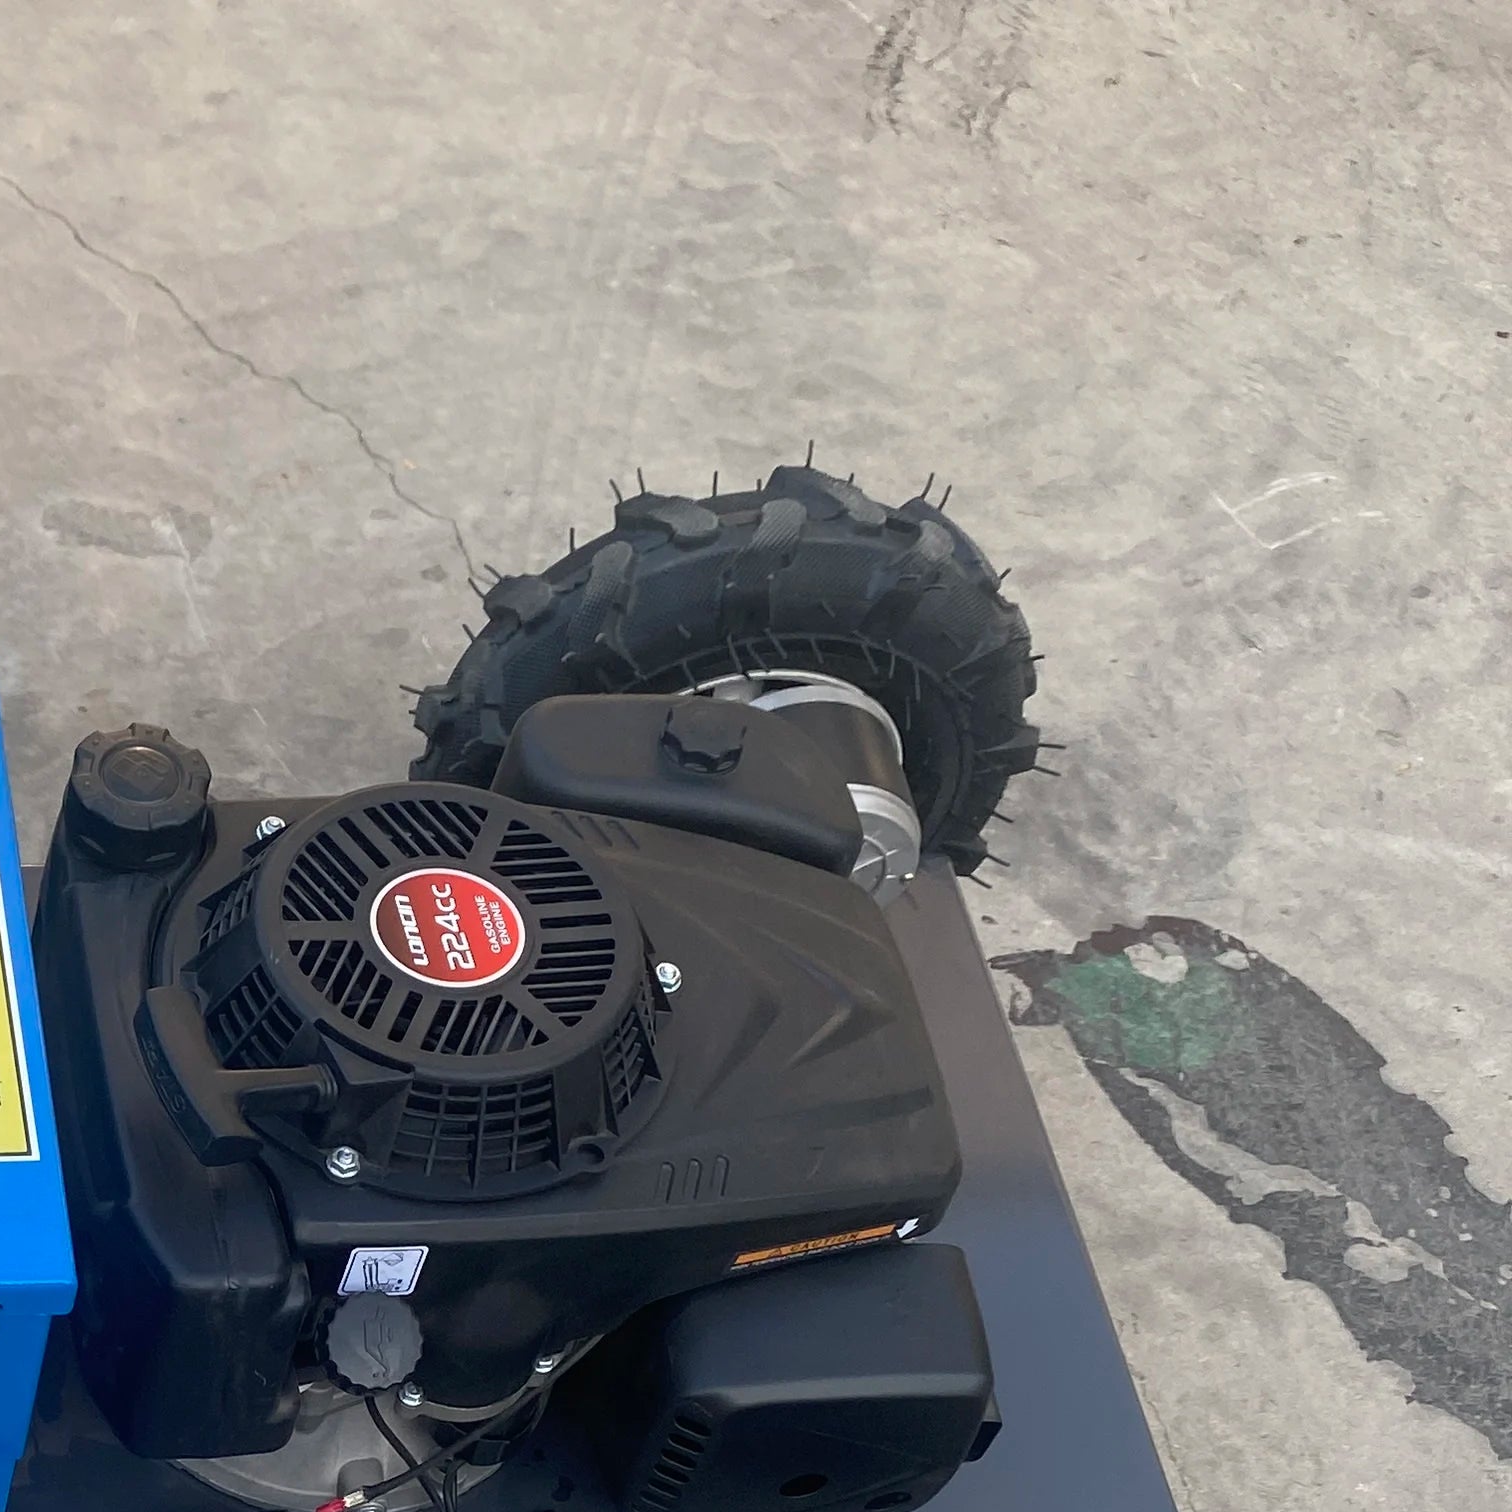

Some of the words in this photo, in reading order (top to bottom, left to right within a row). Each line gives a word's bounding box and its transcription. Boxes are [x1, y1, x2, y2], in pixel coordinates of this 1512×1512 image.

[474, 895, 501, 953] GASOLINE
[489, 901, 511, 946] ENGINE
[790, 1232, 859, 1253] CAUTION
